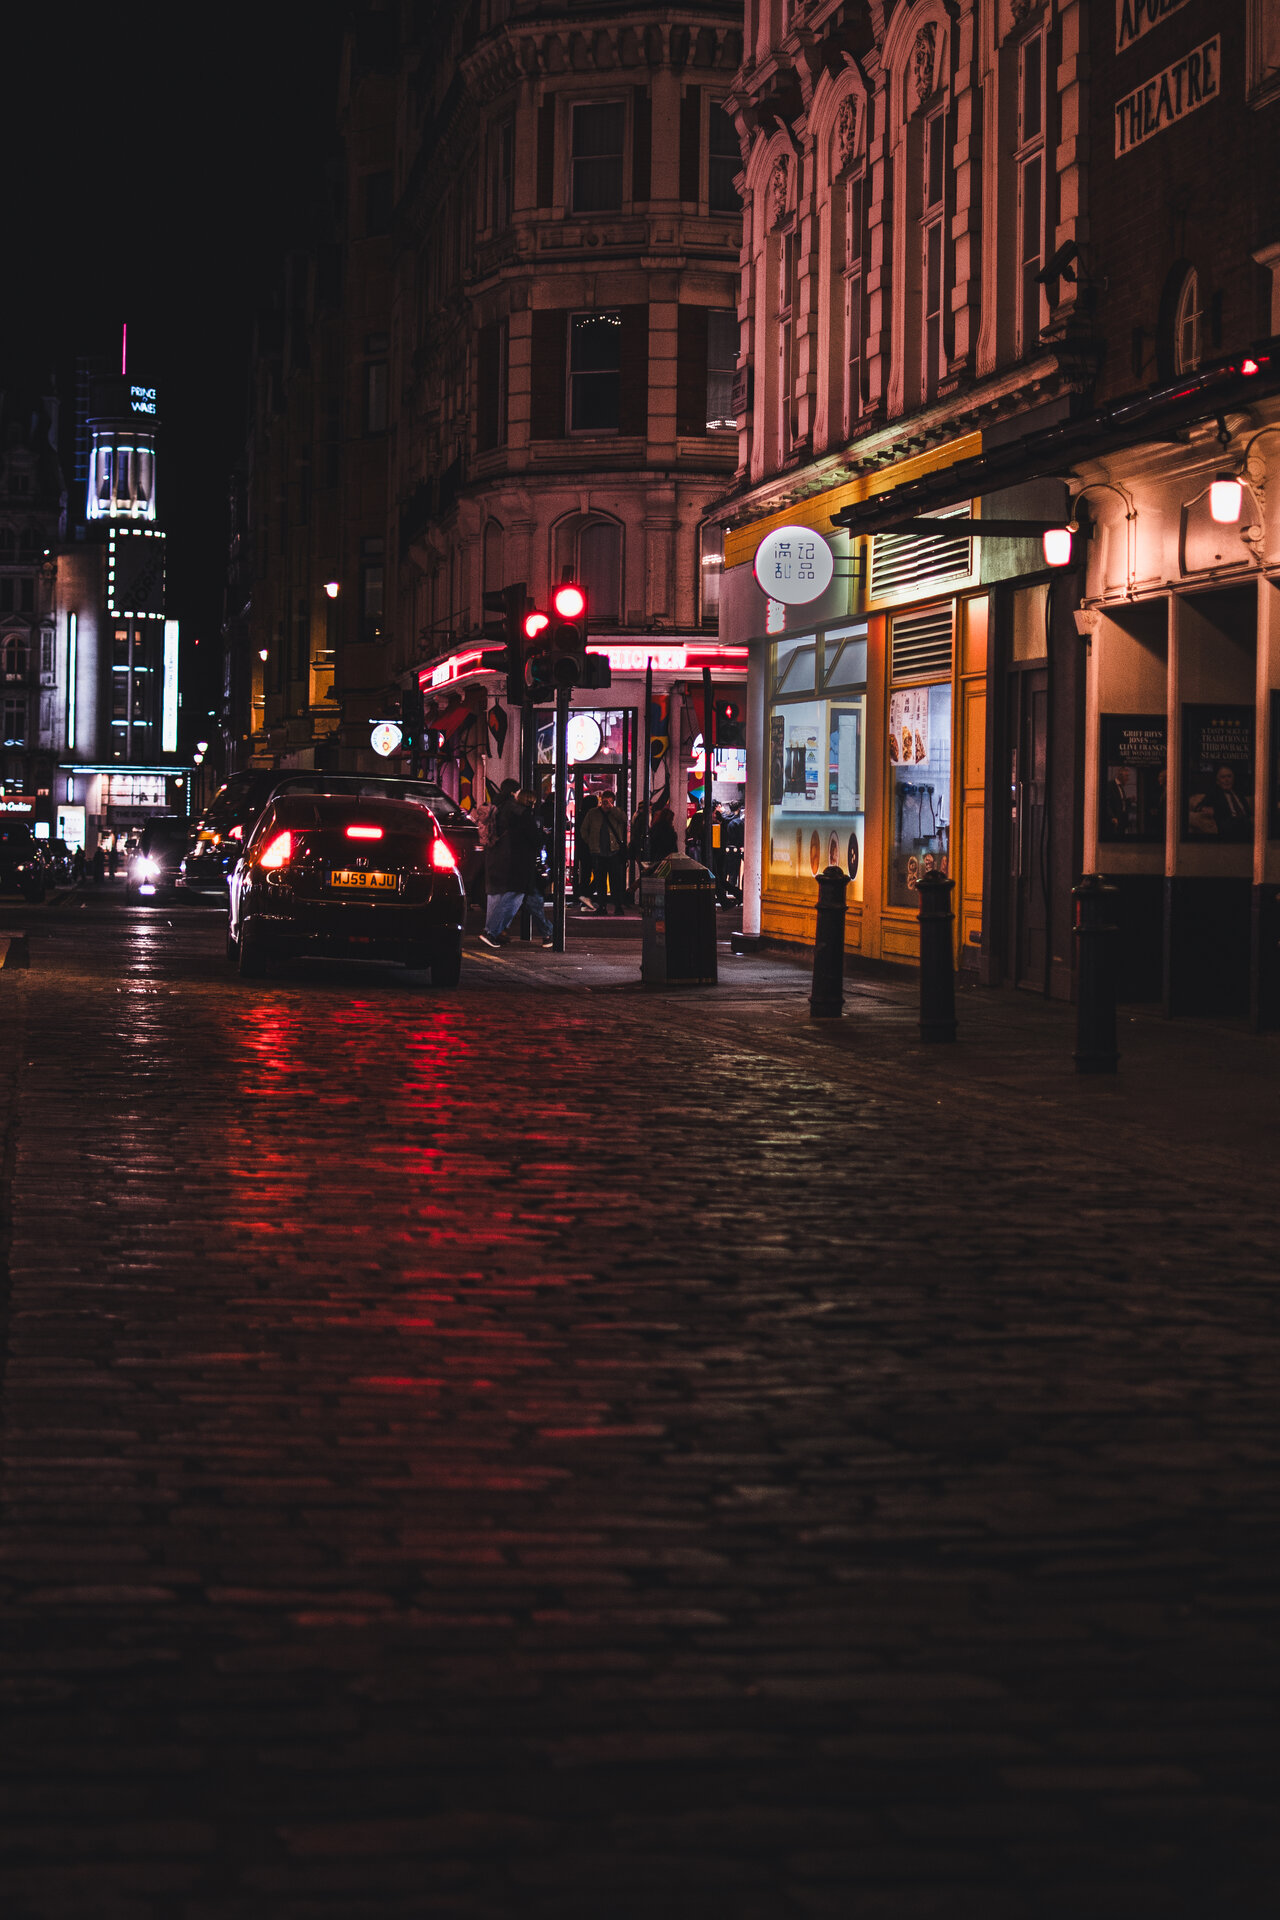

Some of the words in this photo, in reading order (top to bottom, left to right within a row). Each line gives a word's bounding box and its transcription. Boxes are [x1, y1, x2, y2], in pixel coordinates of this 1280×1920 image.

[1116, 40, 1217, 151] THEATRE
[130, 385, 156, 400] PRINCE
[130, 401, 156, 415] WALES
[598, 649, 687, 669] HICKEN
[1201, 734, 1248, 743] TRADITIONAL
[1201, 743, 1248, 751] THROWBACK
[333, 872, 367, 885] MJ59
[370, 873, 395, 887] AJU
